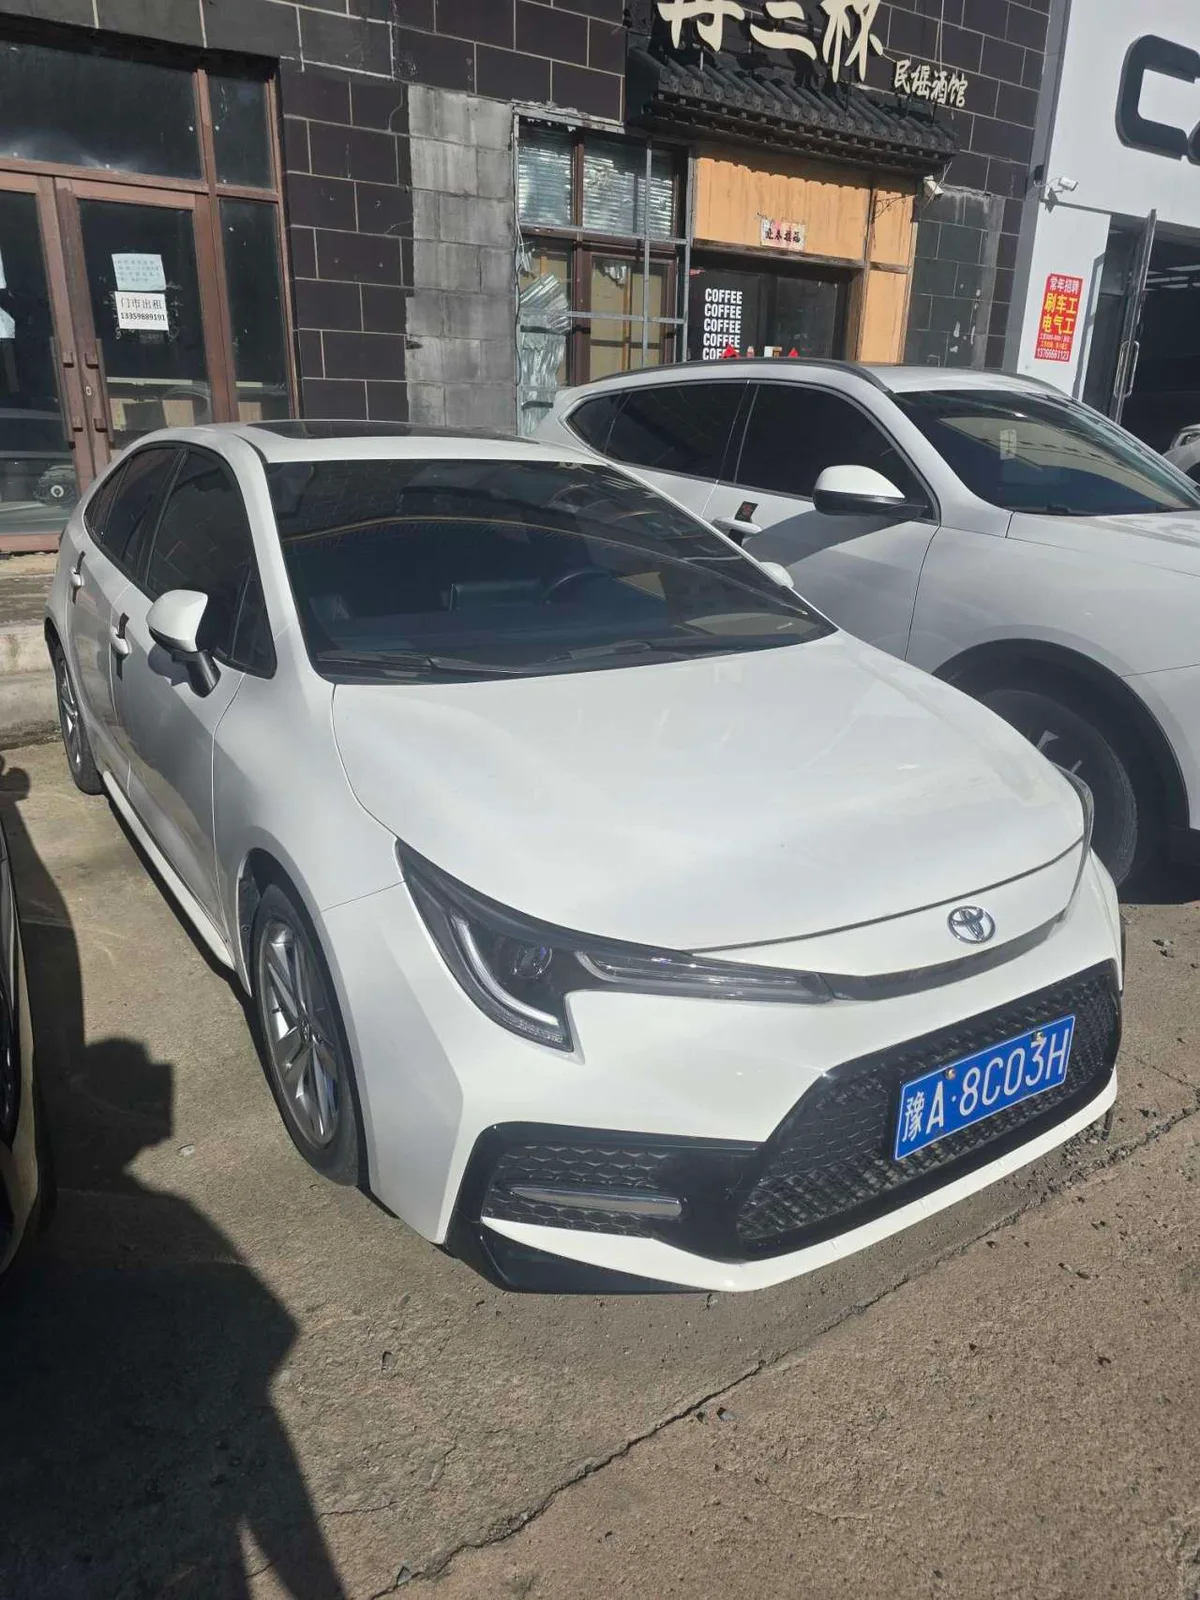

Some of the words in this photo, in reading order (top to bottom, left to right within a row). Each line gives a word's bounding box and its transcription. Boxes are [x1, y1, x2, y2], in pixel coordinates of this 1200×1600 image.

[121, 298, 162, 309] 门市出租
[705, 288, 743, 304] COFFEE
[704, 303, 742, 319] COFFEE
[703, 318, 742, 334] COFFEE
[1042, 313, 1075, 335] 电气工
[703, 332, 741, 348] COFFEE
